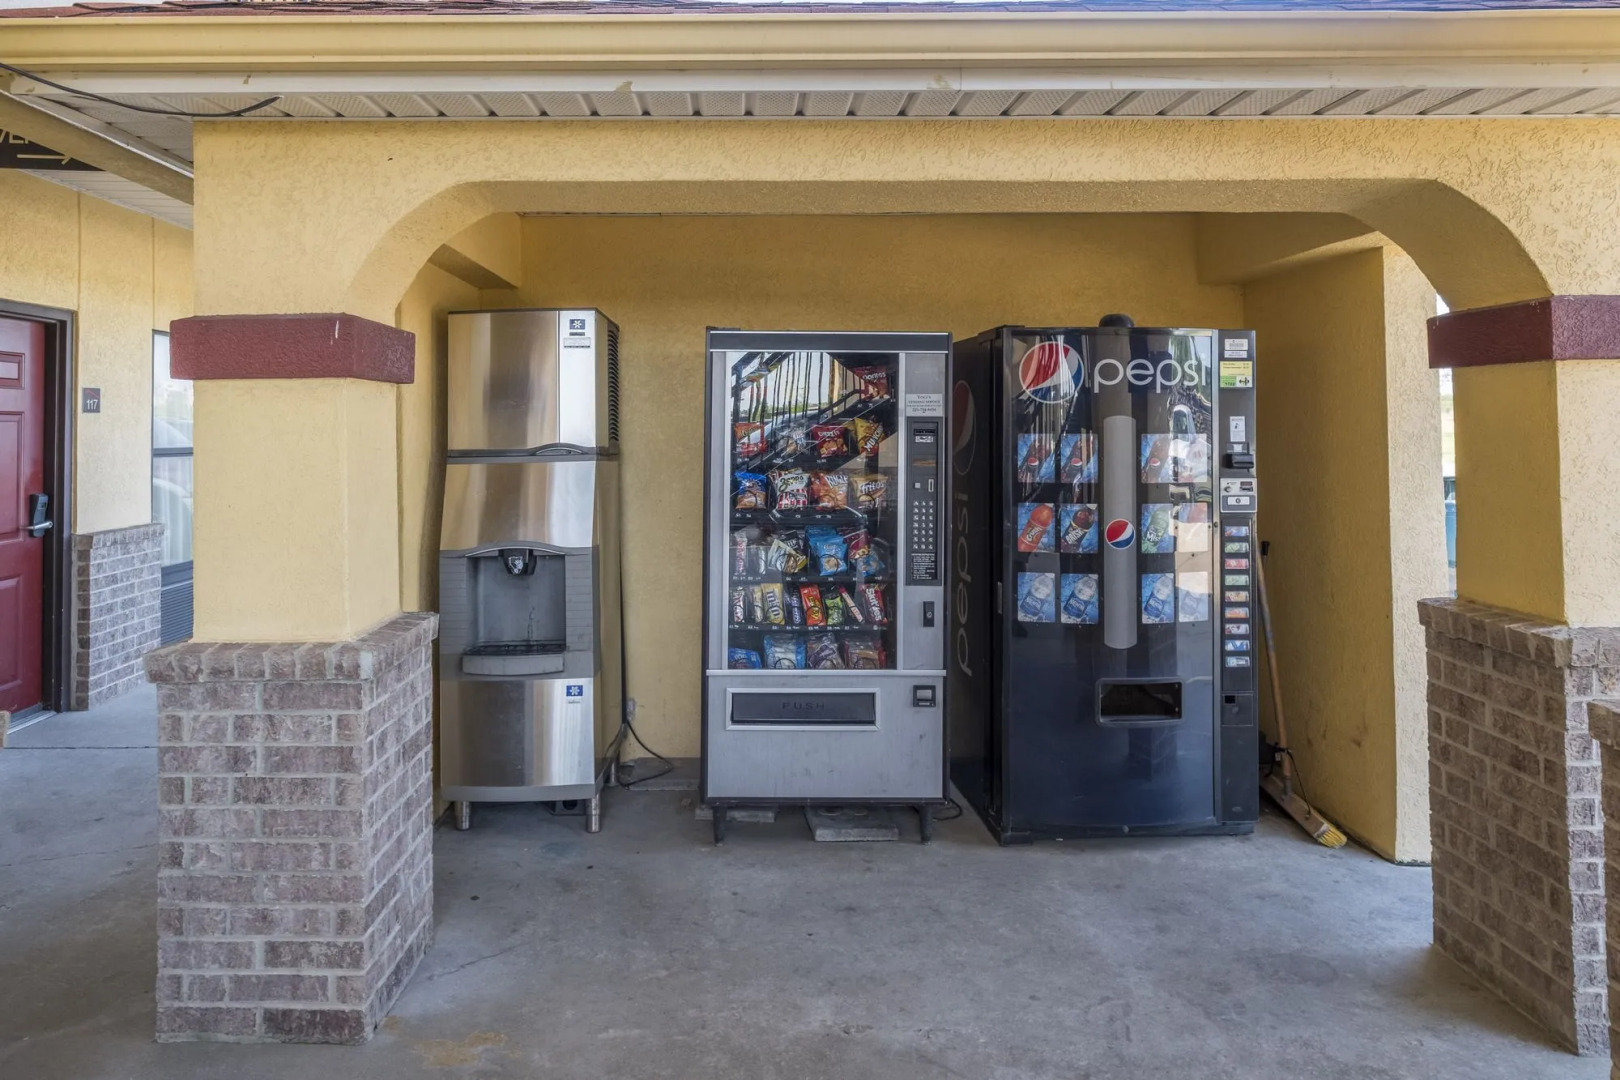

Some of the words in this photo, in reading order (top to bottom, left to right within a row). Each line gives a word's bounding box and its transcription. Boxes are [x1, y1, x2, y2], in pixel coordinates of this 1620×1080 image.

[1093, 357, 1206, 394] pepsi
[86, 399, 98, 410] 117
[954, 494, 973, 678] pepsi
[782, 702, 825, 710] PUSH
